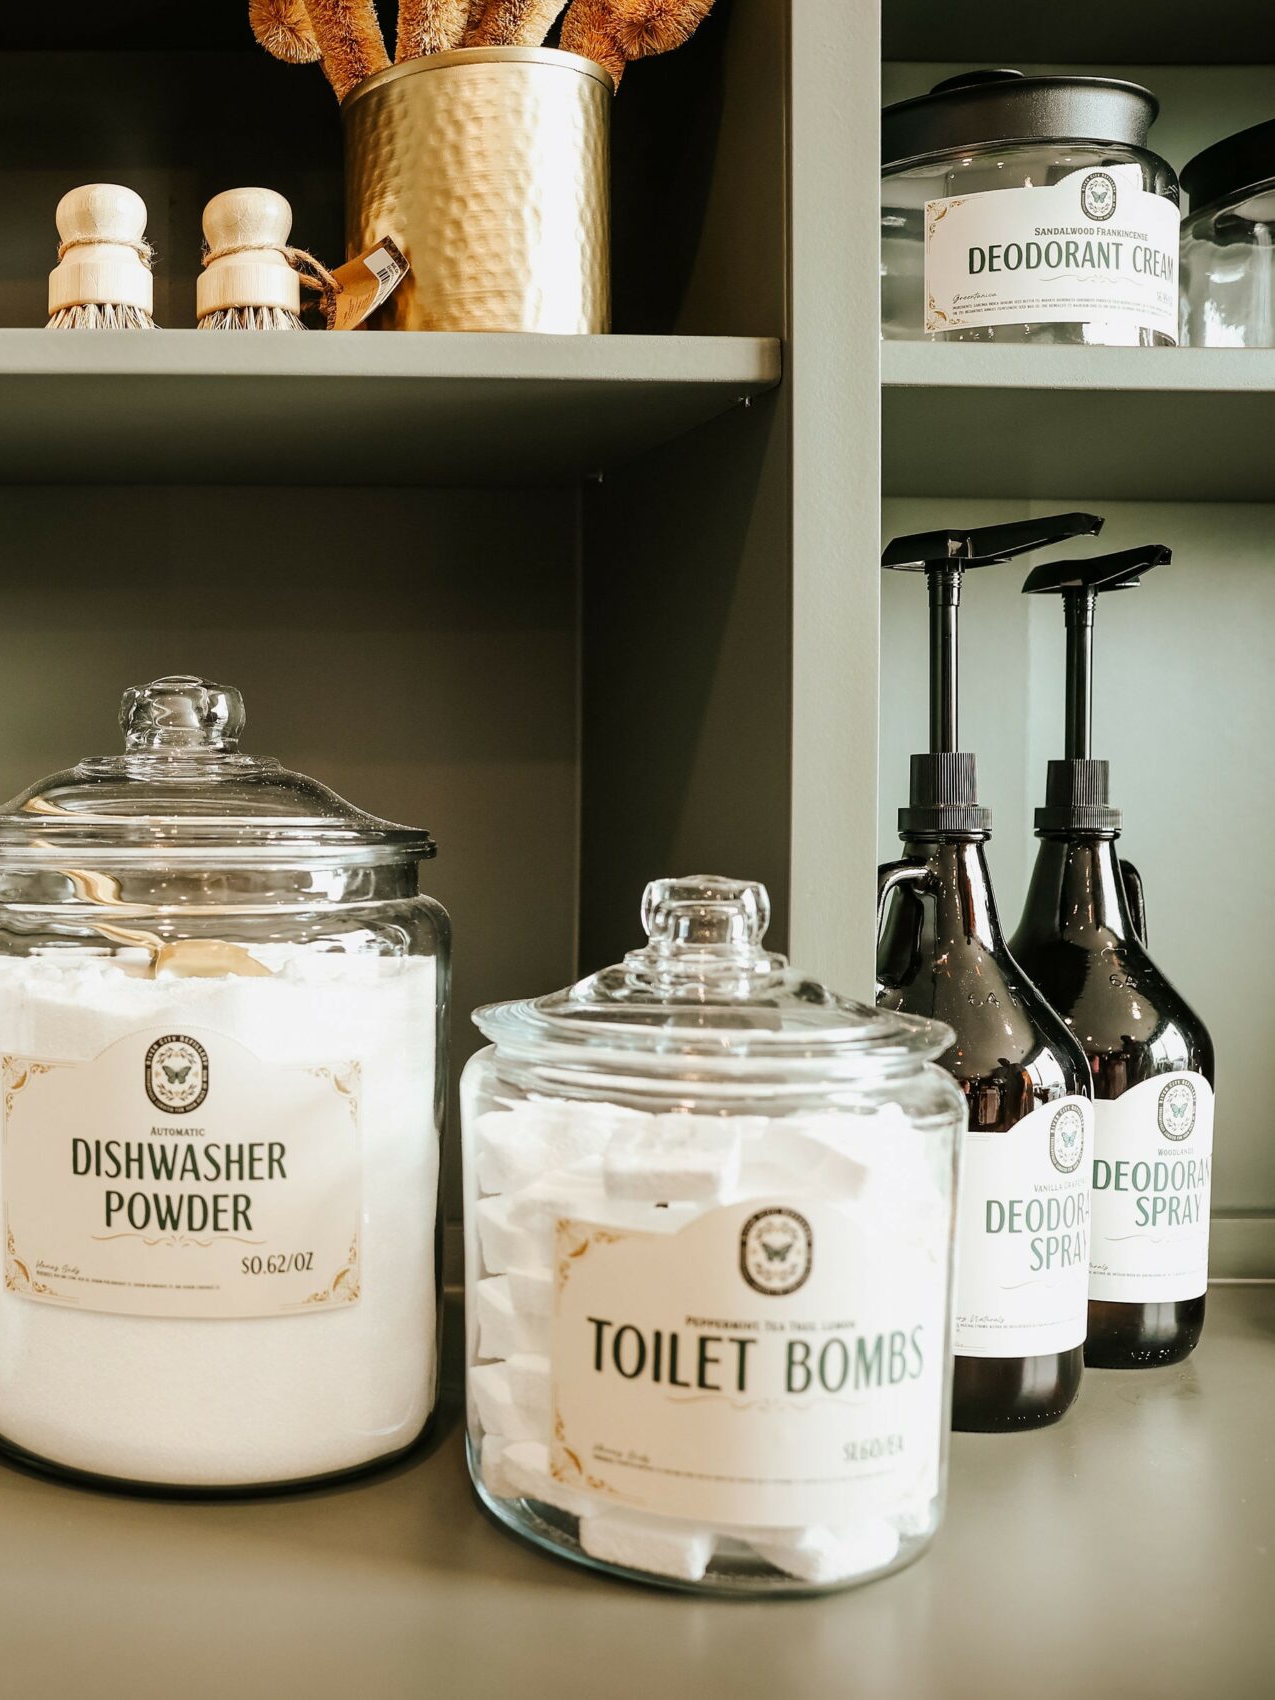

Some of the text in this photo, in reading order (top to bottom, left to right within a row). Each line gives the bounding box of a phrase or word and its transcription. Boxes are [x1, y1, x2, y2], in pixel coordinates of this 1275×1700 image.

[1034, 227, 1149, 242] SANDALWOOD FRANKINCENSE
[968, 240, 1174, 284] DEODORANT CREAM
[71, 1136, 288, 1183] DISHWASHER
[104, 1189, 254, 1233] POWDER
[1135, 1192, 1202, 1227] SPRAY
[240, 1250, 316, 1276] $0.62/OZ
[586, 1315, 925, 1394] TOILET BOMBS
